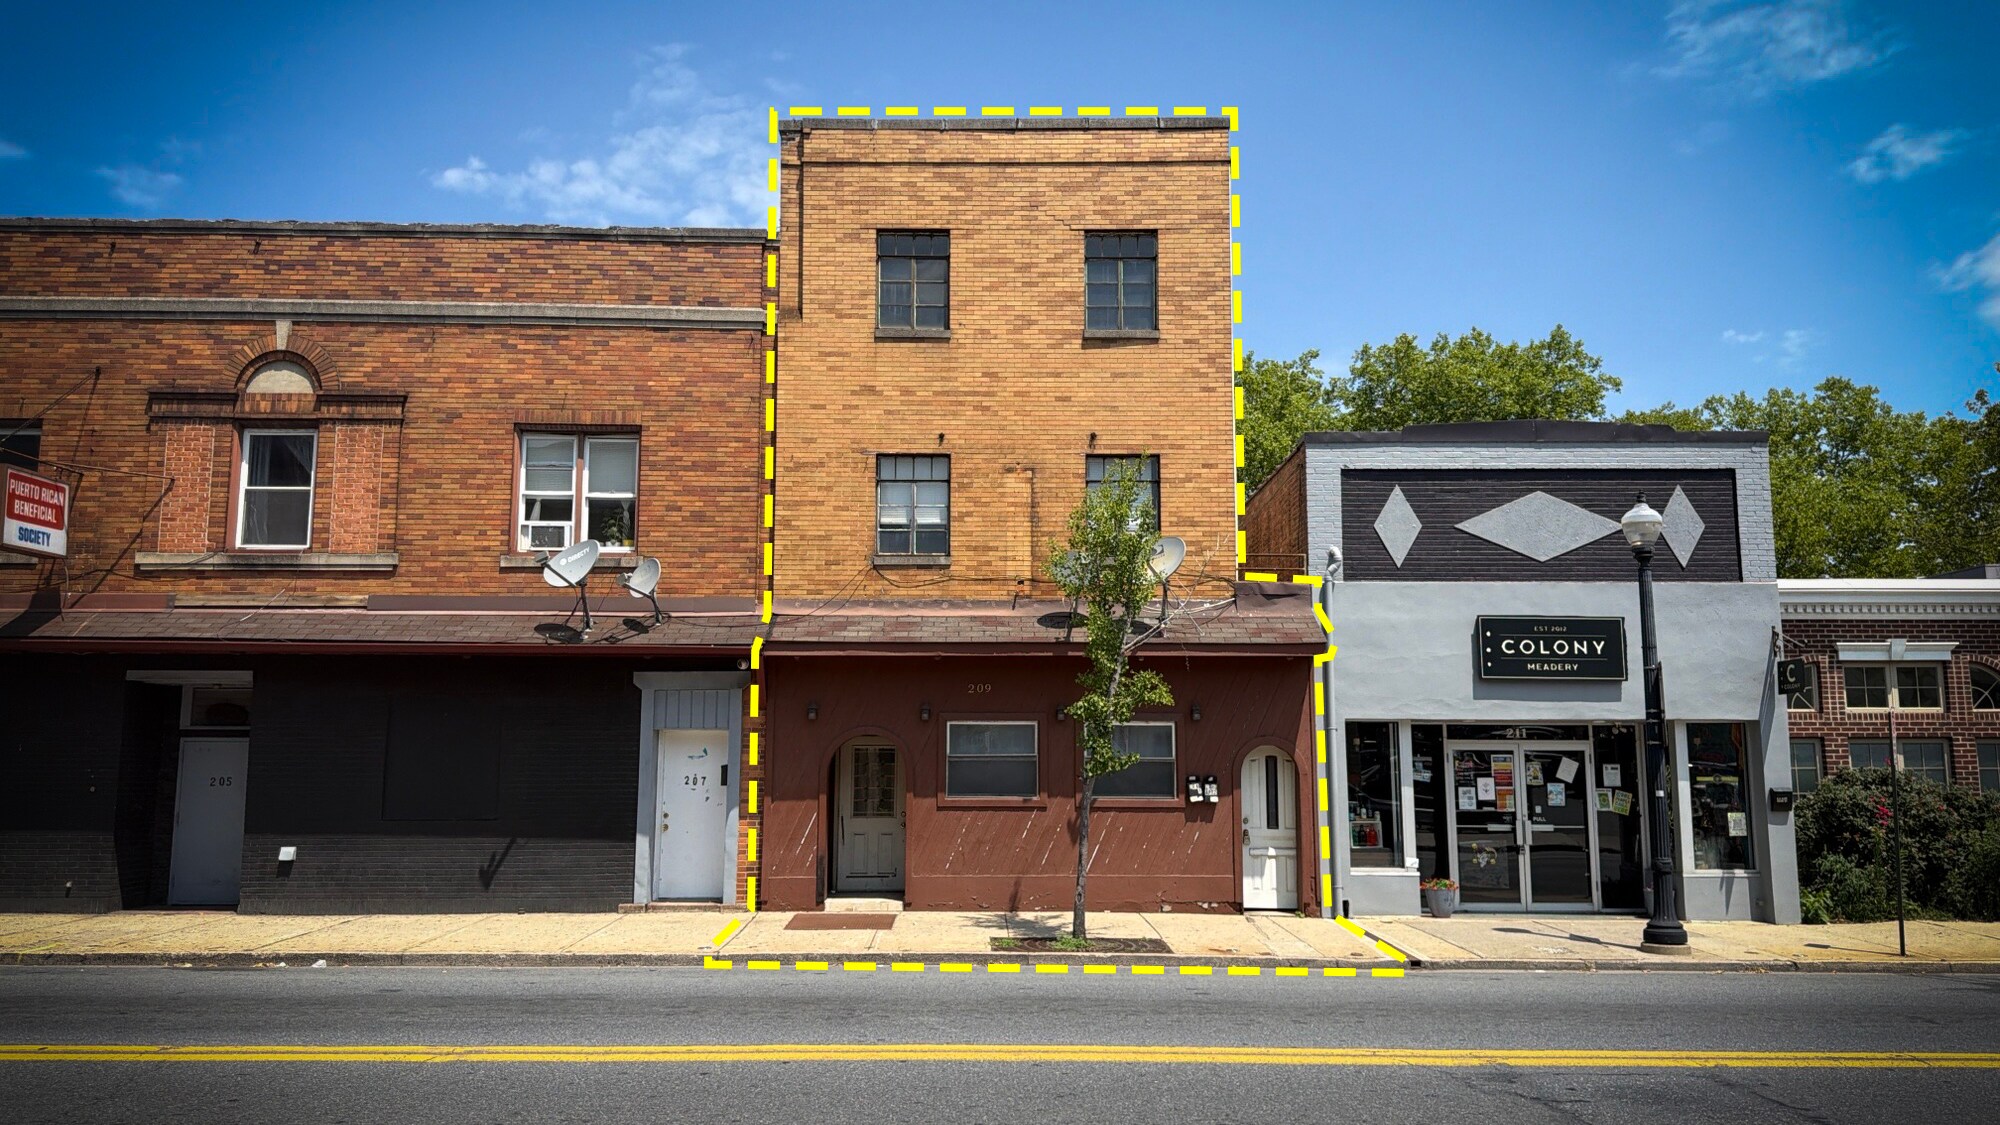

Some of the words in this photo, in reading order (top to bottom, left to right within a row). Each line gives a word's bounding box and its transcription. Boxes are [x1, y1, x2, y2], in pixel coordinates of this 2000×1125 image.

[9, 479, 40, 500] PUERTO
[41, 488, 64, 507] RICAN
[14, 499, 57, 523] BENEFICIAL
[18, 526, 51, 547] SOCIETY
[567, 546, 590, 563] DIRECTV
[1501, 639, 1605, 655] COLONY
[1527, 663, 1578, 671] MEADERY
[1786, 664, 1796, 682] C
[967, 683, 992, 694] 209
[1506, 728, 1528, 739] 211
[209, 776, 233, 787] 205
[684, 775, 707, 786] 207
